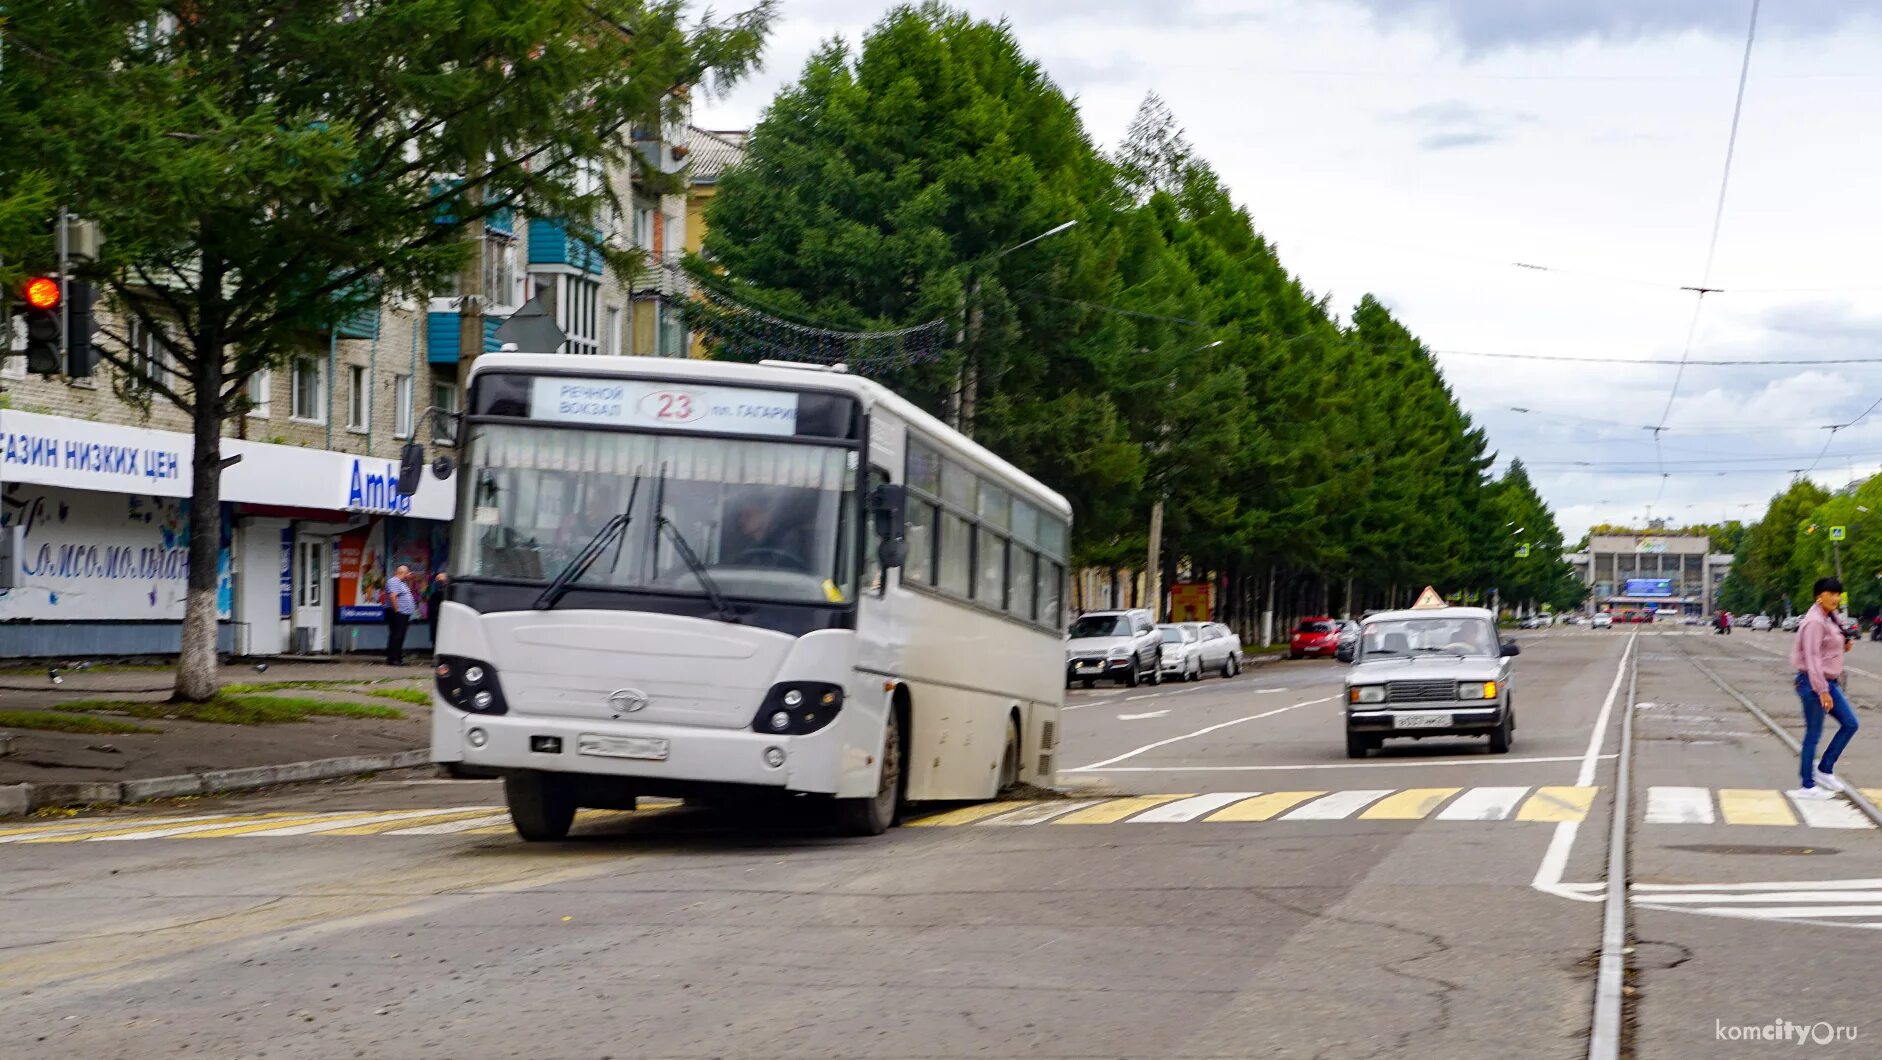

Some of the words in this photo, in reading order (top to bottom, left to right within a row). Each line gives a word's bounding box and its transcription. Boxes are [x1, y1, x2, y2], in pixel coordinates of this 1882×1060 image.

[560, 385, 624, 401] РЕЧНОЙ
[560, 401, 621, 417] ВОКЗАЛ
[657, 392, 692, 418] 23
[65, 440, 139, 476] НИЗКИХ
[144, 449, 179, 483] ЦЕН
